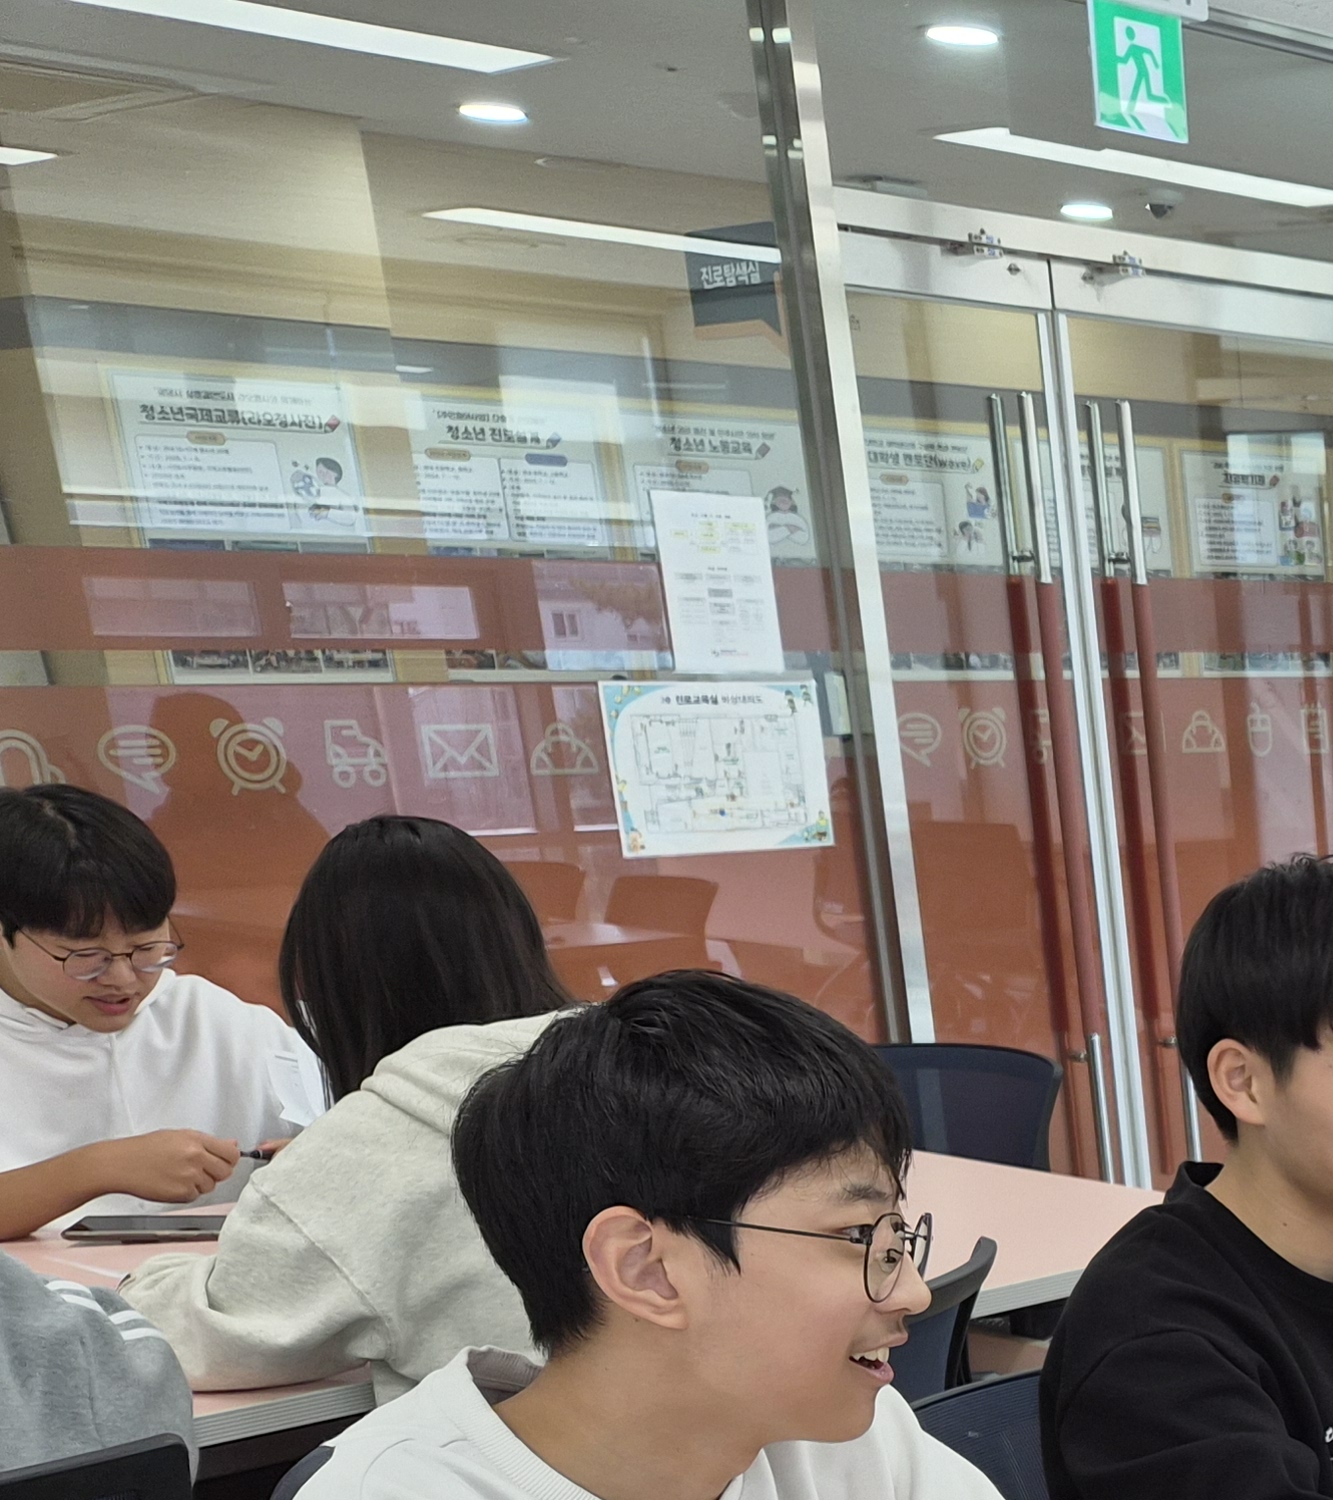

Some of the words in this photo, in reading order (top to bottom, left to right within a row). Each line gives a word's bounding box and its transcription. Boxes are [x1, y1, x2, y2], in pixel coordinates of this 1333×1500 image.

[700, 260, 762, 290] 진로탐색실
[446, 425, 486, 441] 청소년
[670, 436, 705, 452] 청소년
